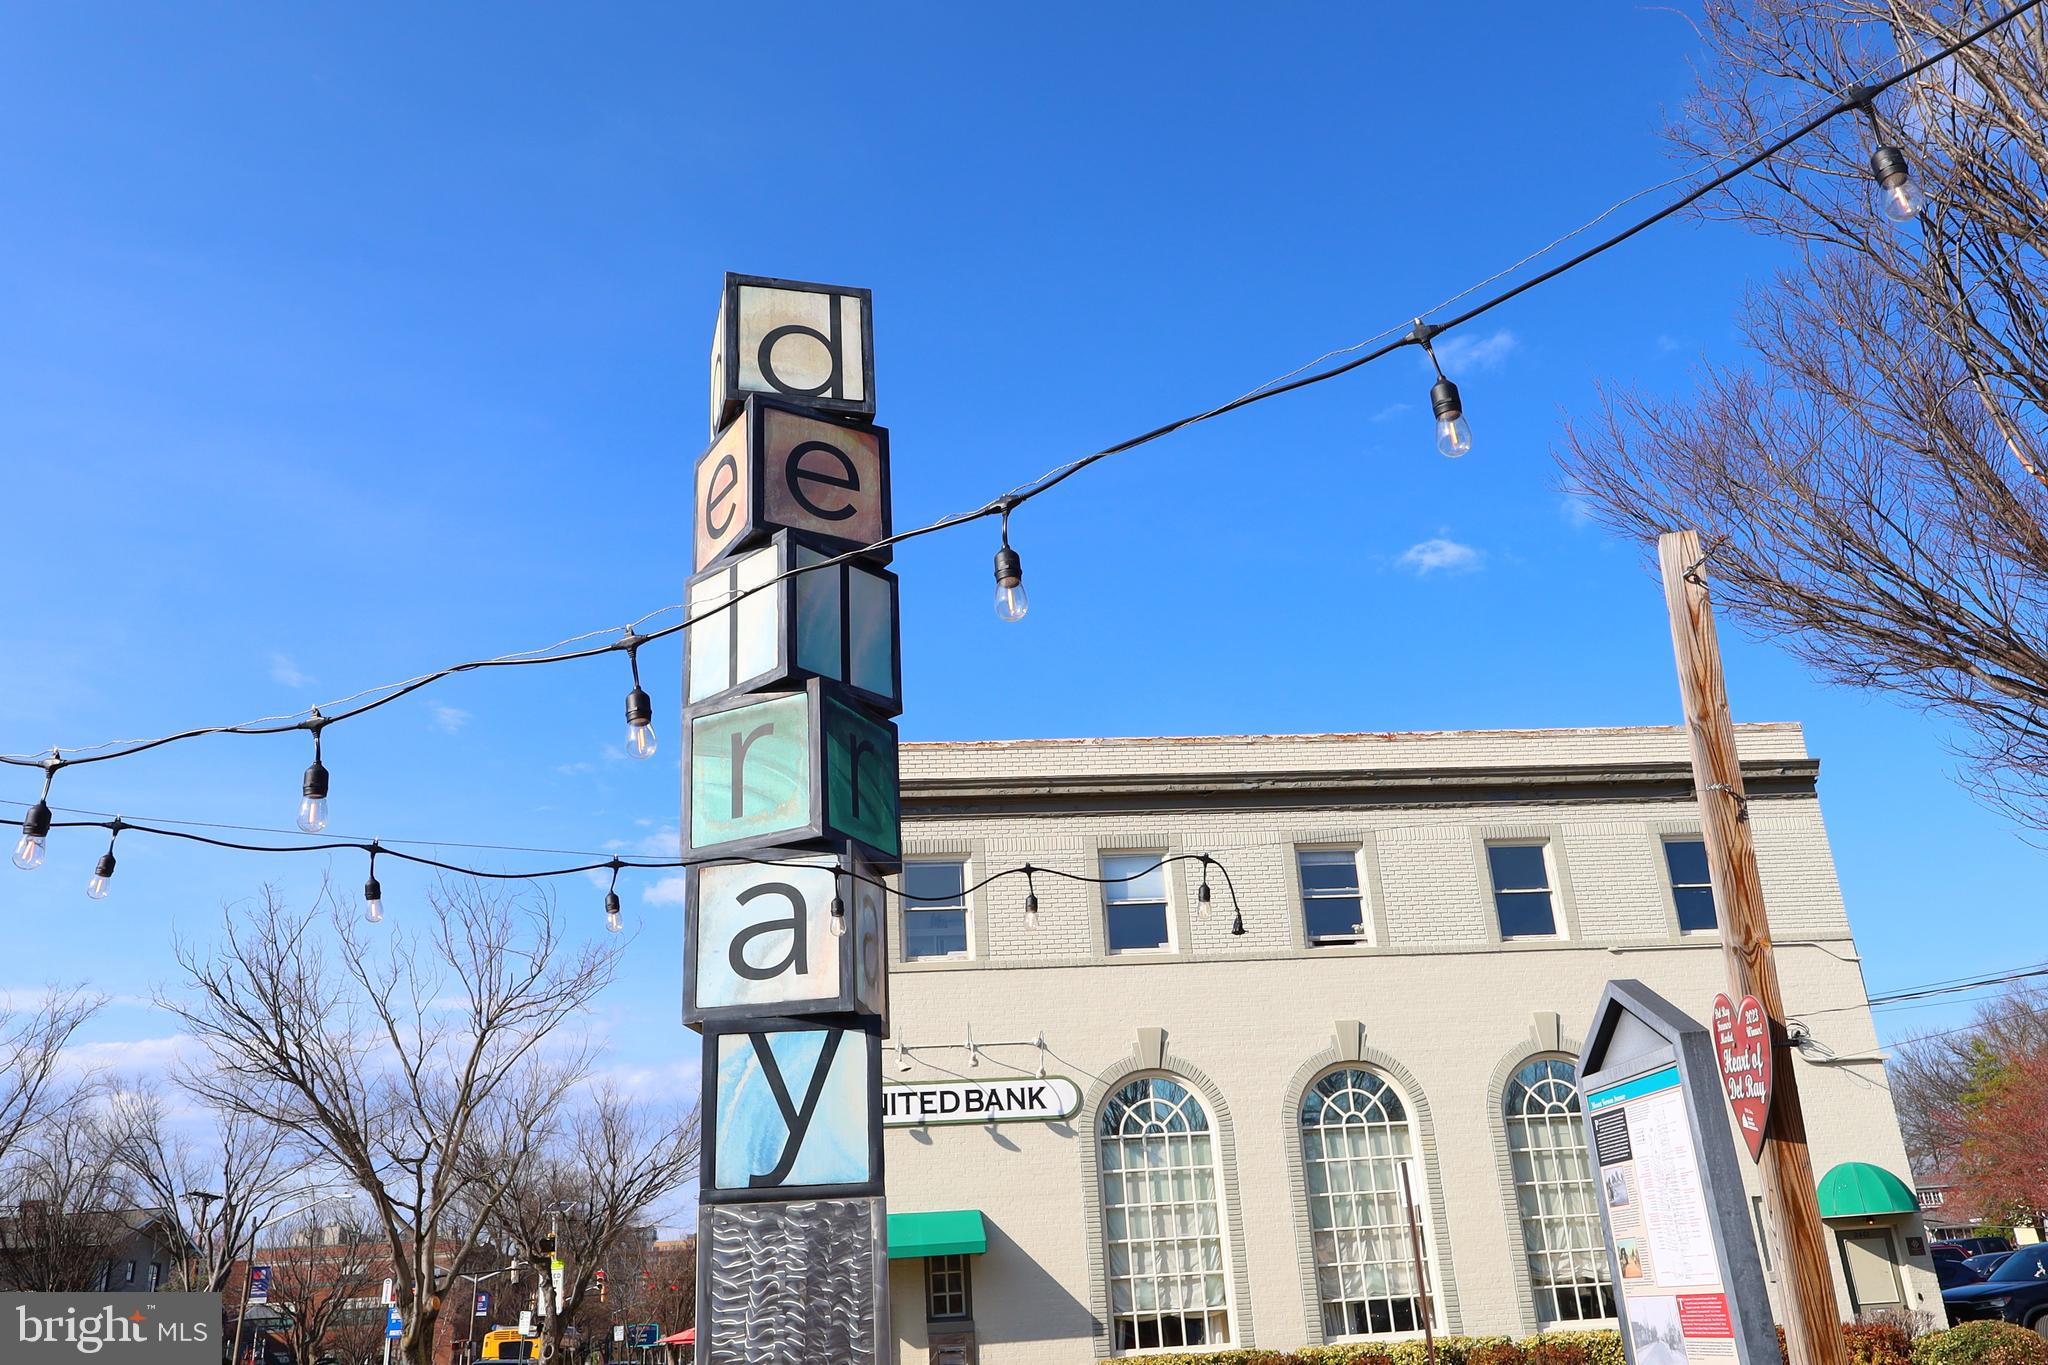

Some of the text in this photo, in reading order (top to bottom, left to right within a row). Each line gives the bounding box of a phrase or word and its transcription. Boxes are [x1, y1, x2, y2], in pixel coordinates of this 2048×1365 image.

[1745, 1007, 1760, 1025] 2023
[1723, 1042, 1764, 1077] Heart of
[964, 1086, 1047, 1113] BANK
[1728, 1074, 1767, 1104] Del Ray
